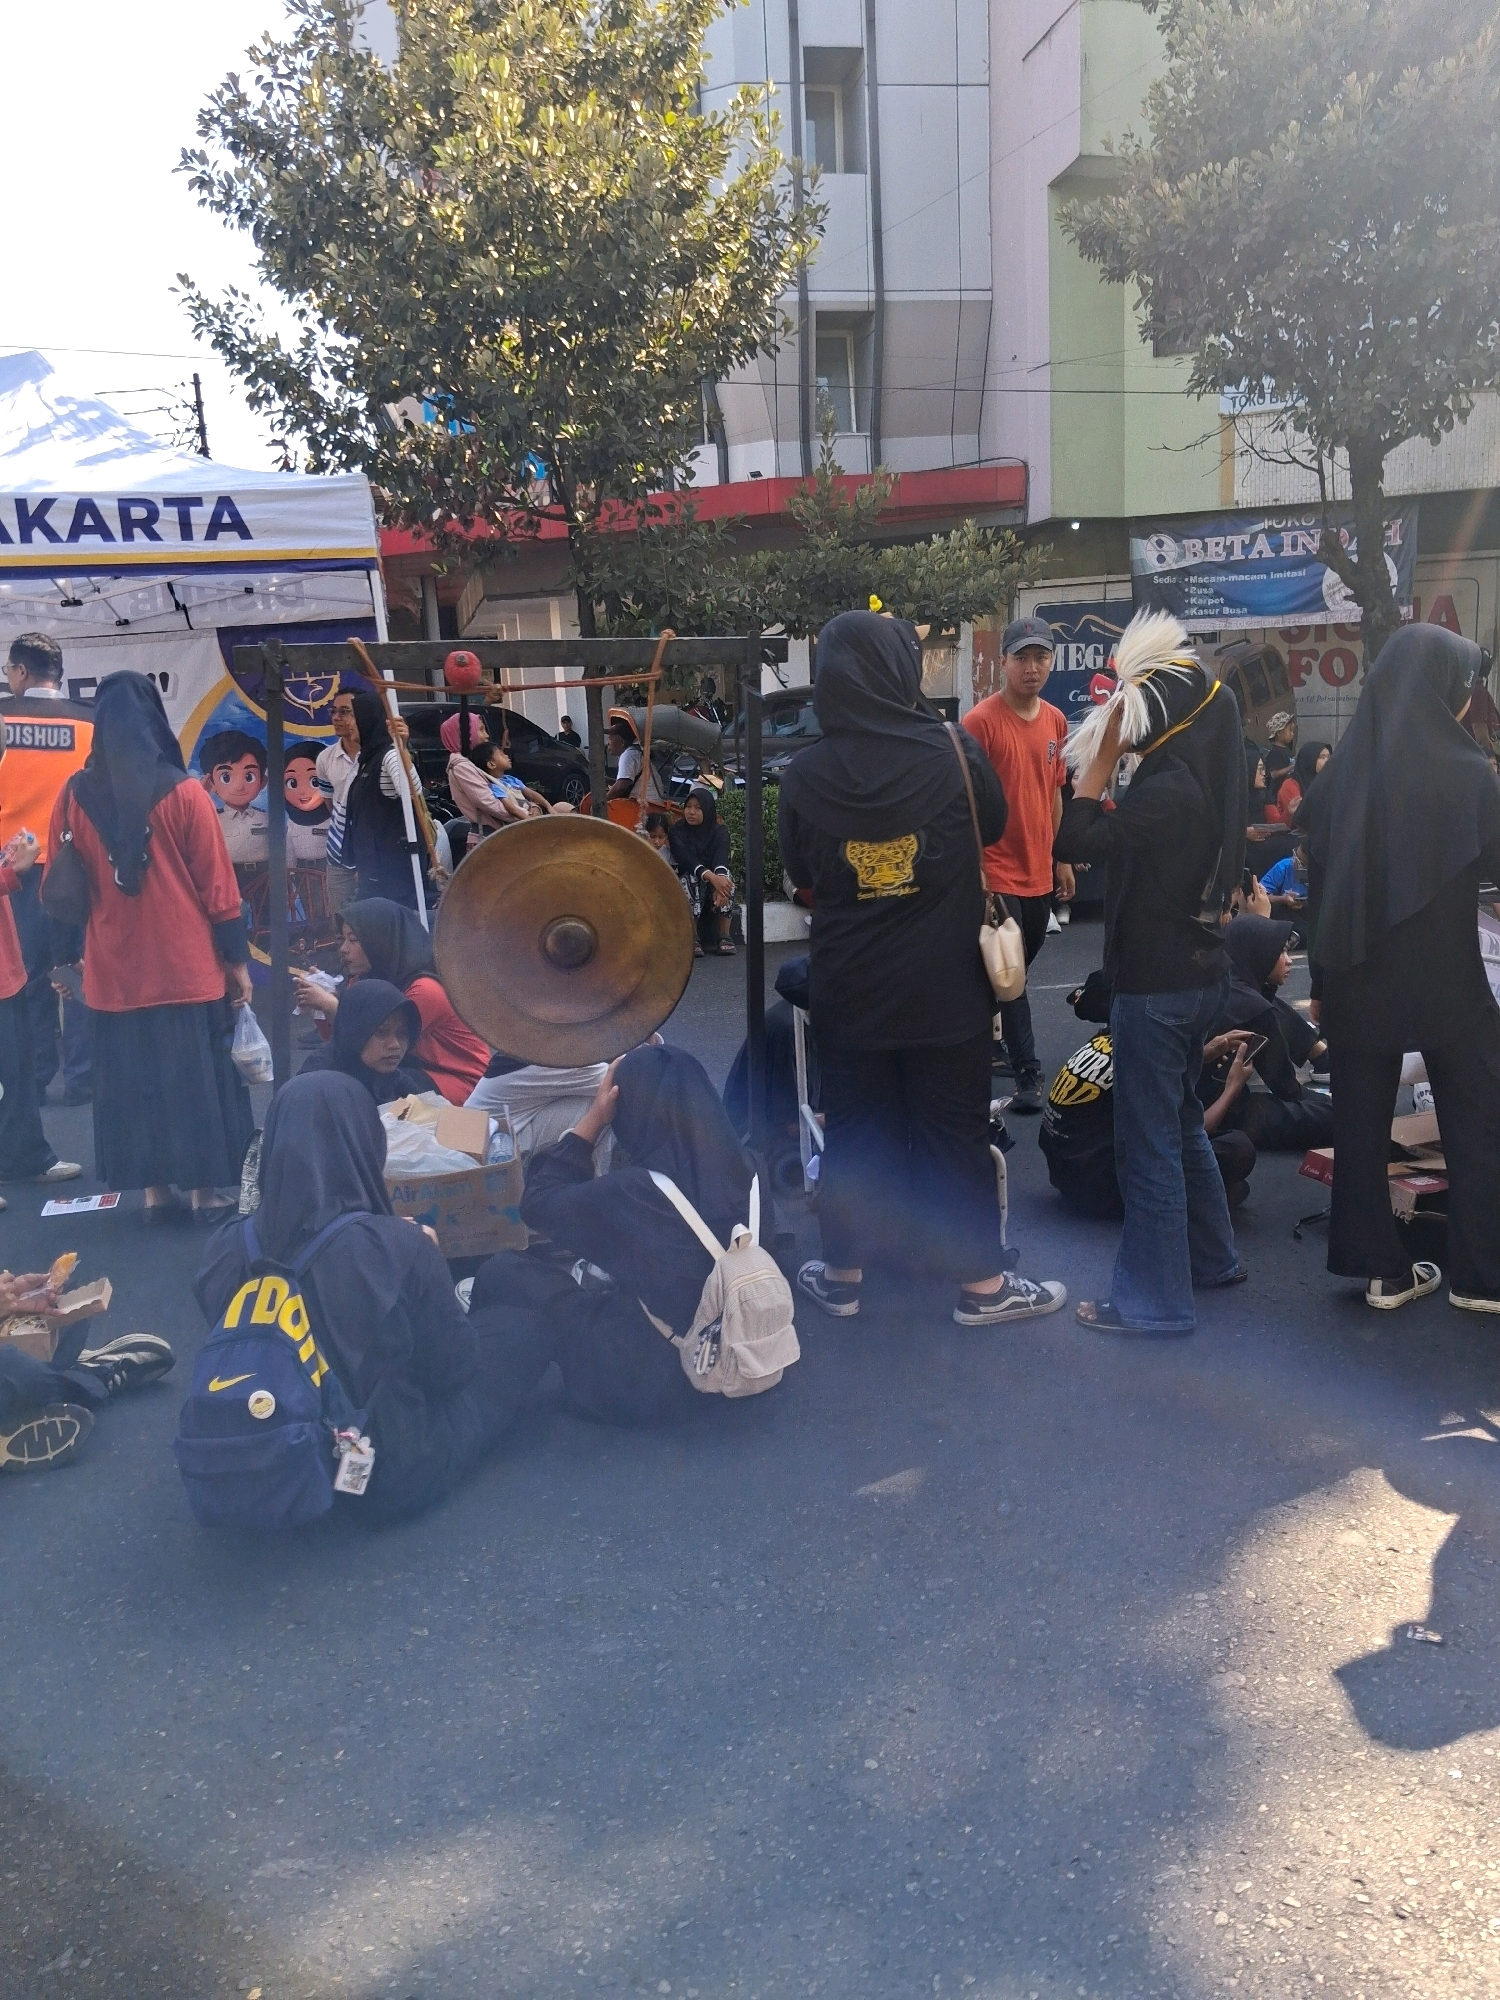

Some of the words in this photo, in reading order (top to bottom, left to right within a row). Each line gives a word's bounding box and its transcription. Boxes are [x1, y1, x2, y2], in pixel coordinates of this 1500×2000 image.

[0, 496, 253, 544] KARTA
[1182, 533, 1275, 563] BETA
[1190, 597, 1225, 606] Karpet
[1191, 608, 1221, 616] Kasur
[1223, 607, 1248, 615] Busa
[1287, 648, 1364, 688] FO
